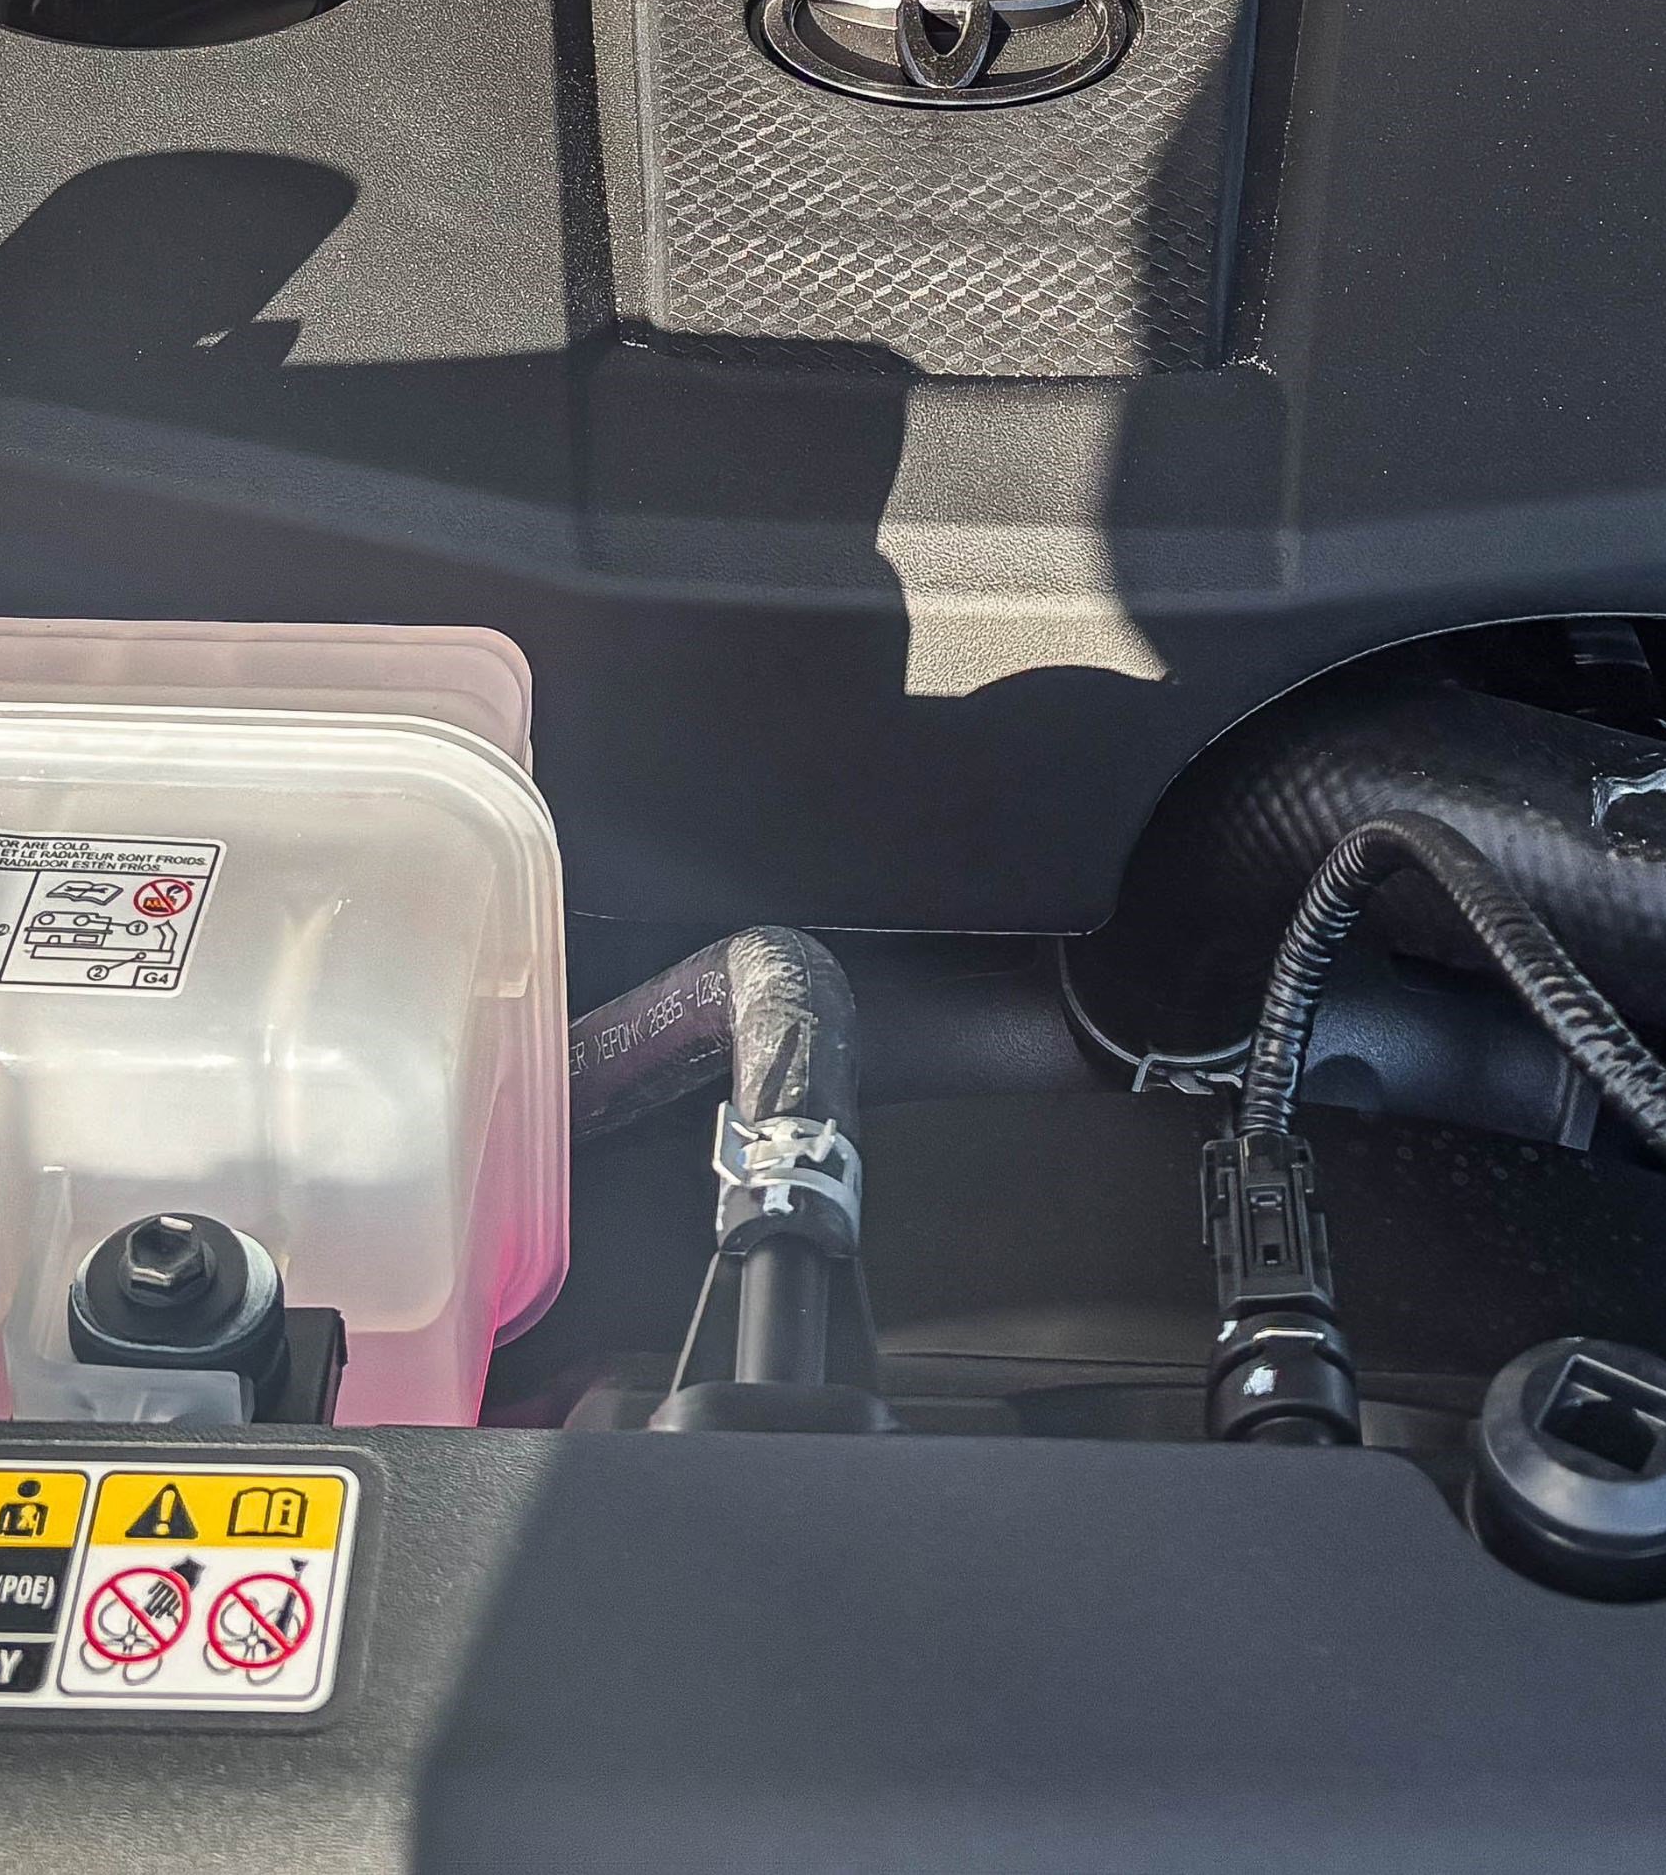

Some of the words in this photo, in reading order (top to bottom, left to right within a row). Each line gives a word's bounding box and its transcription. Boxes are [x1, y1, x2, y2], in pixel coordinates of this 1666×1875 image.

[20, 840, 49, 850] ARE
[0, 847, 19, 858] ET
[19, 849, 38, 859] LE
[39, 849, 114, 863] RADIATEUR
[116, 852, 154, 863] SONT
[154, 854, 205, 866] FROIDS.
[142, 971, 169, 985] G4
